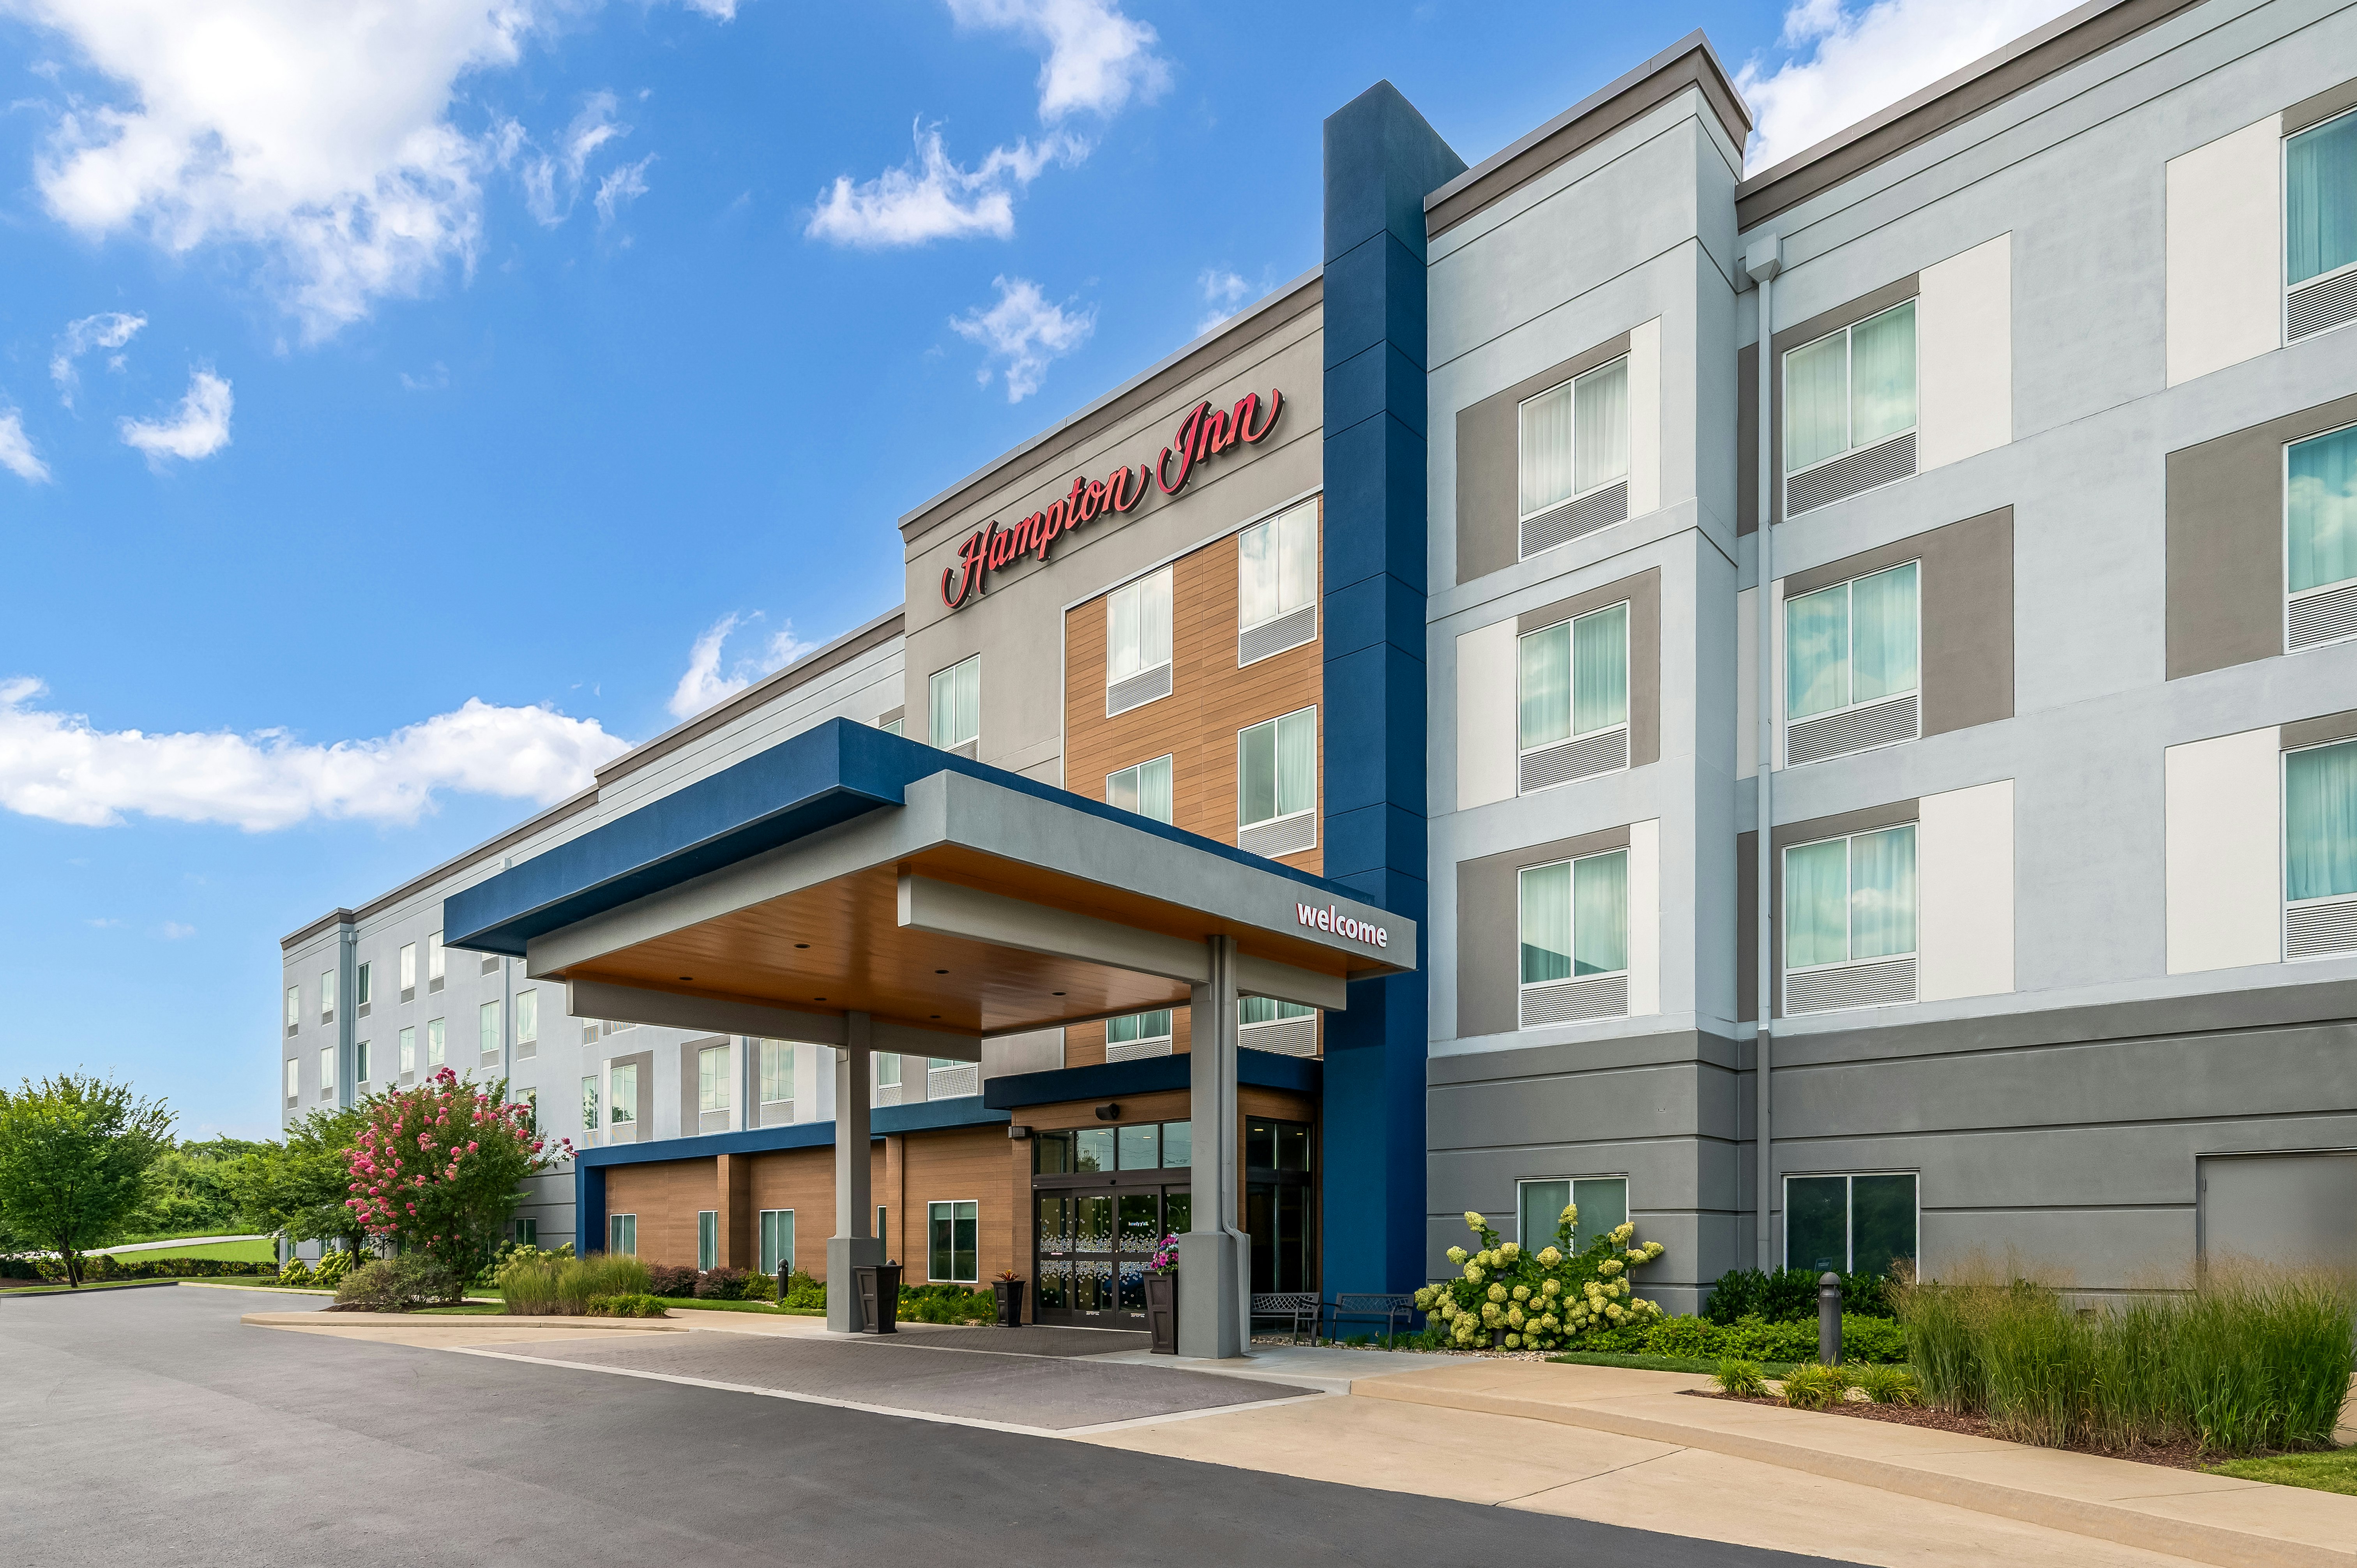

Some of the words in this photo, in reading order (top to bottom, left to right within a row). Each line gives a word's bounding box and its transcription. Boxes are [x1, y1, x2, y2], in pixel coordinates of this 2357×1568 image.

[941, 464, 1152, 609] Hampton
[1157, 388, 1284, 495] Inn
[1296, 902, 1387, 947] welcome
